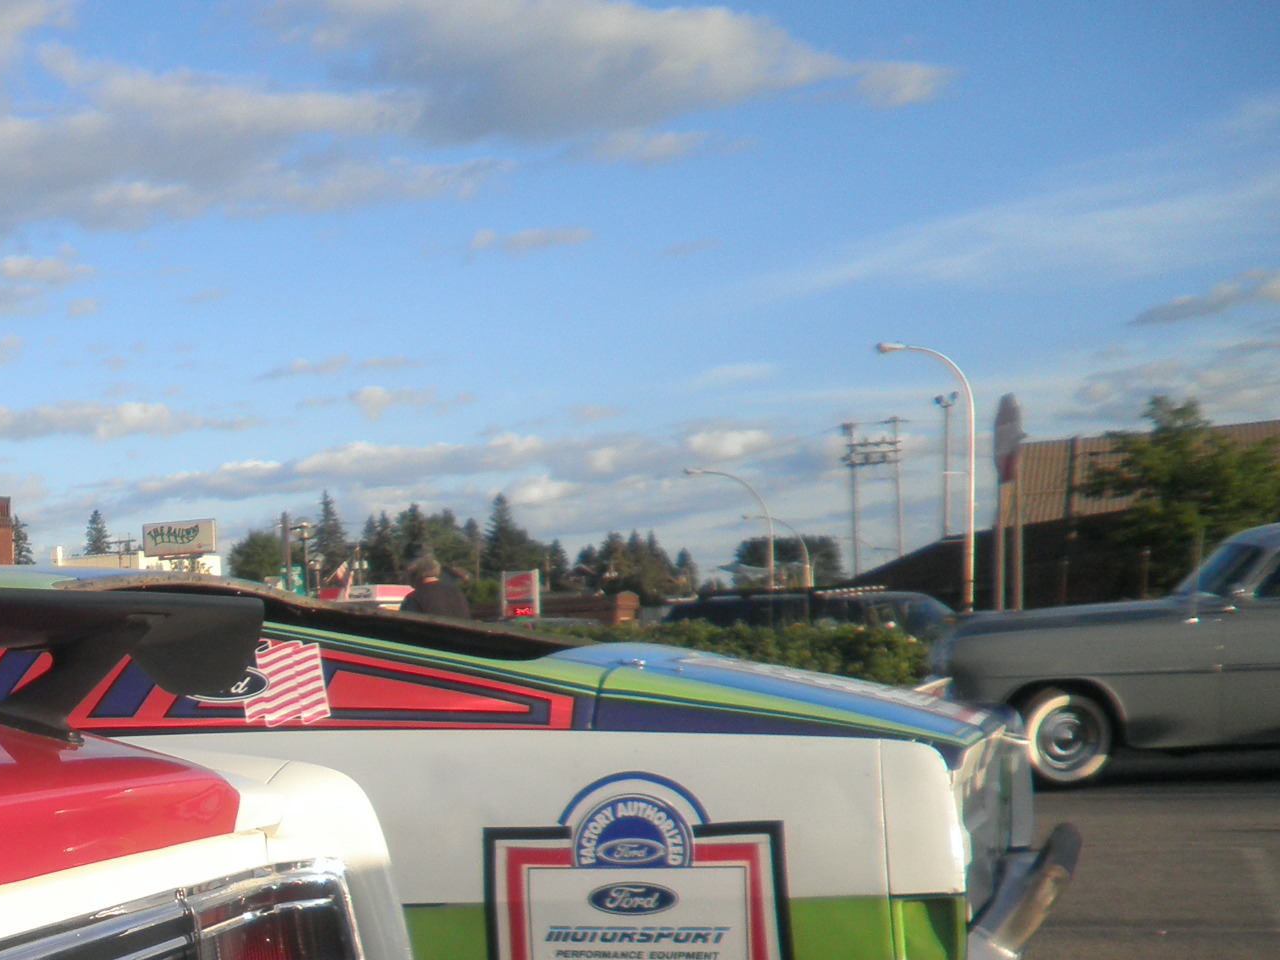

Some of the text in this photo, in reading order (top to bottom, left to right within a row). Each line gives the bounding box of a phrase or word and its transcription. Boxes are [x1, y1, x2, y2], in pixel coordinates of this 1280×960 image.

[580, 801, 684, 866] FACTORY AUTHORIZED
[613, 843, 649, 859] Ford
[604, 886, 661, 909] Ford
[545, 925, 731, 944] MOTORSPORT
[555, 949, 720, 960] PERFORMANCE EQUIPMENT
